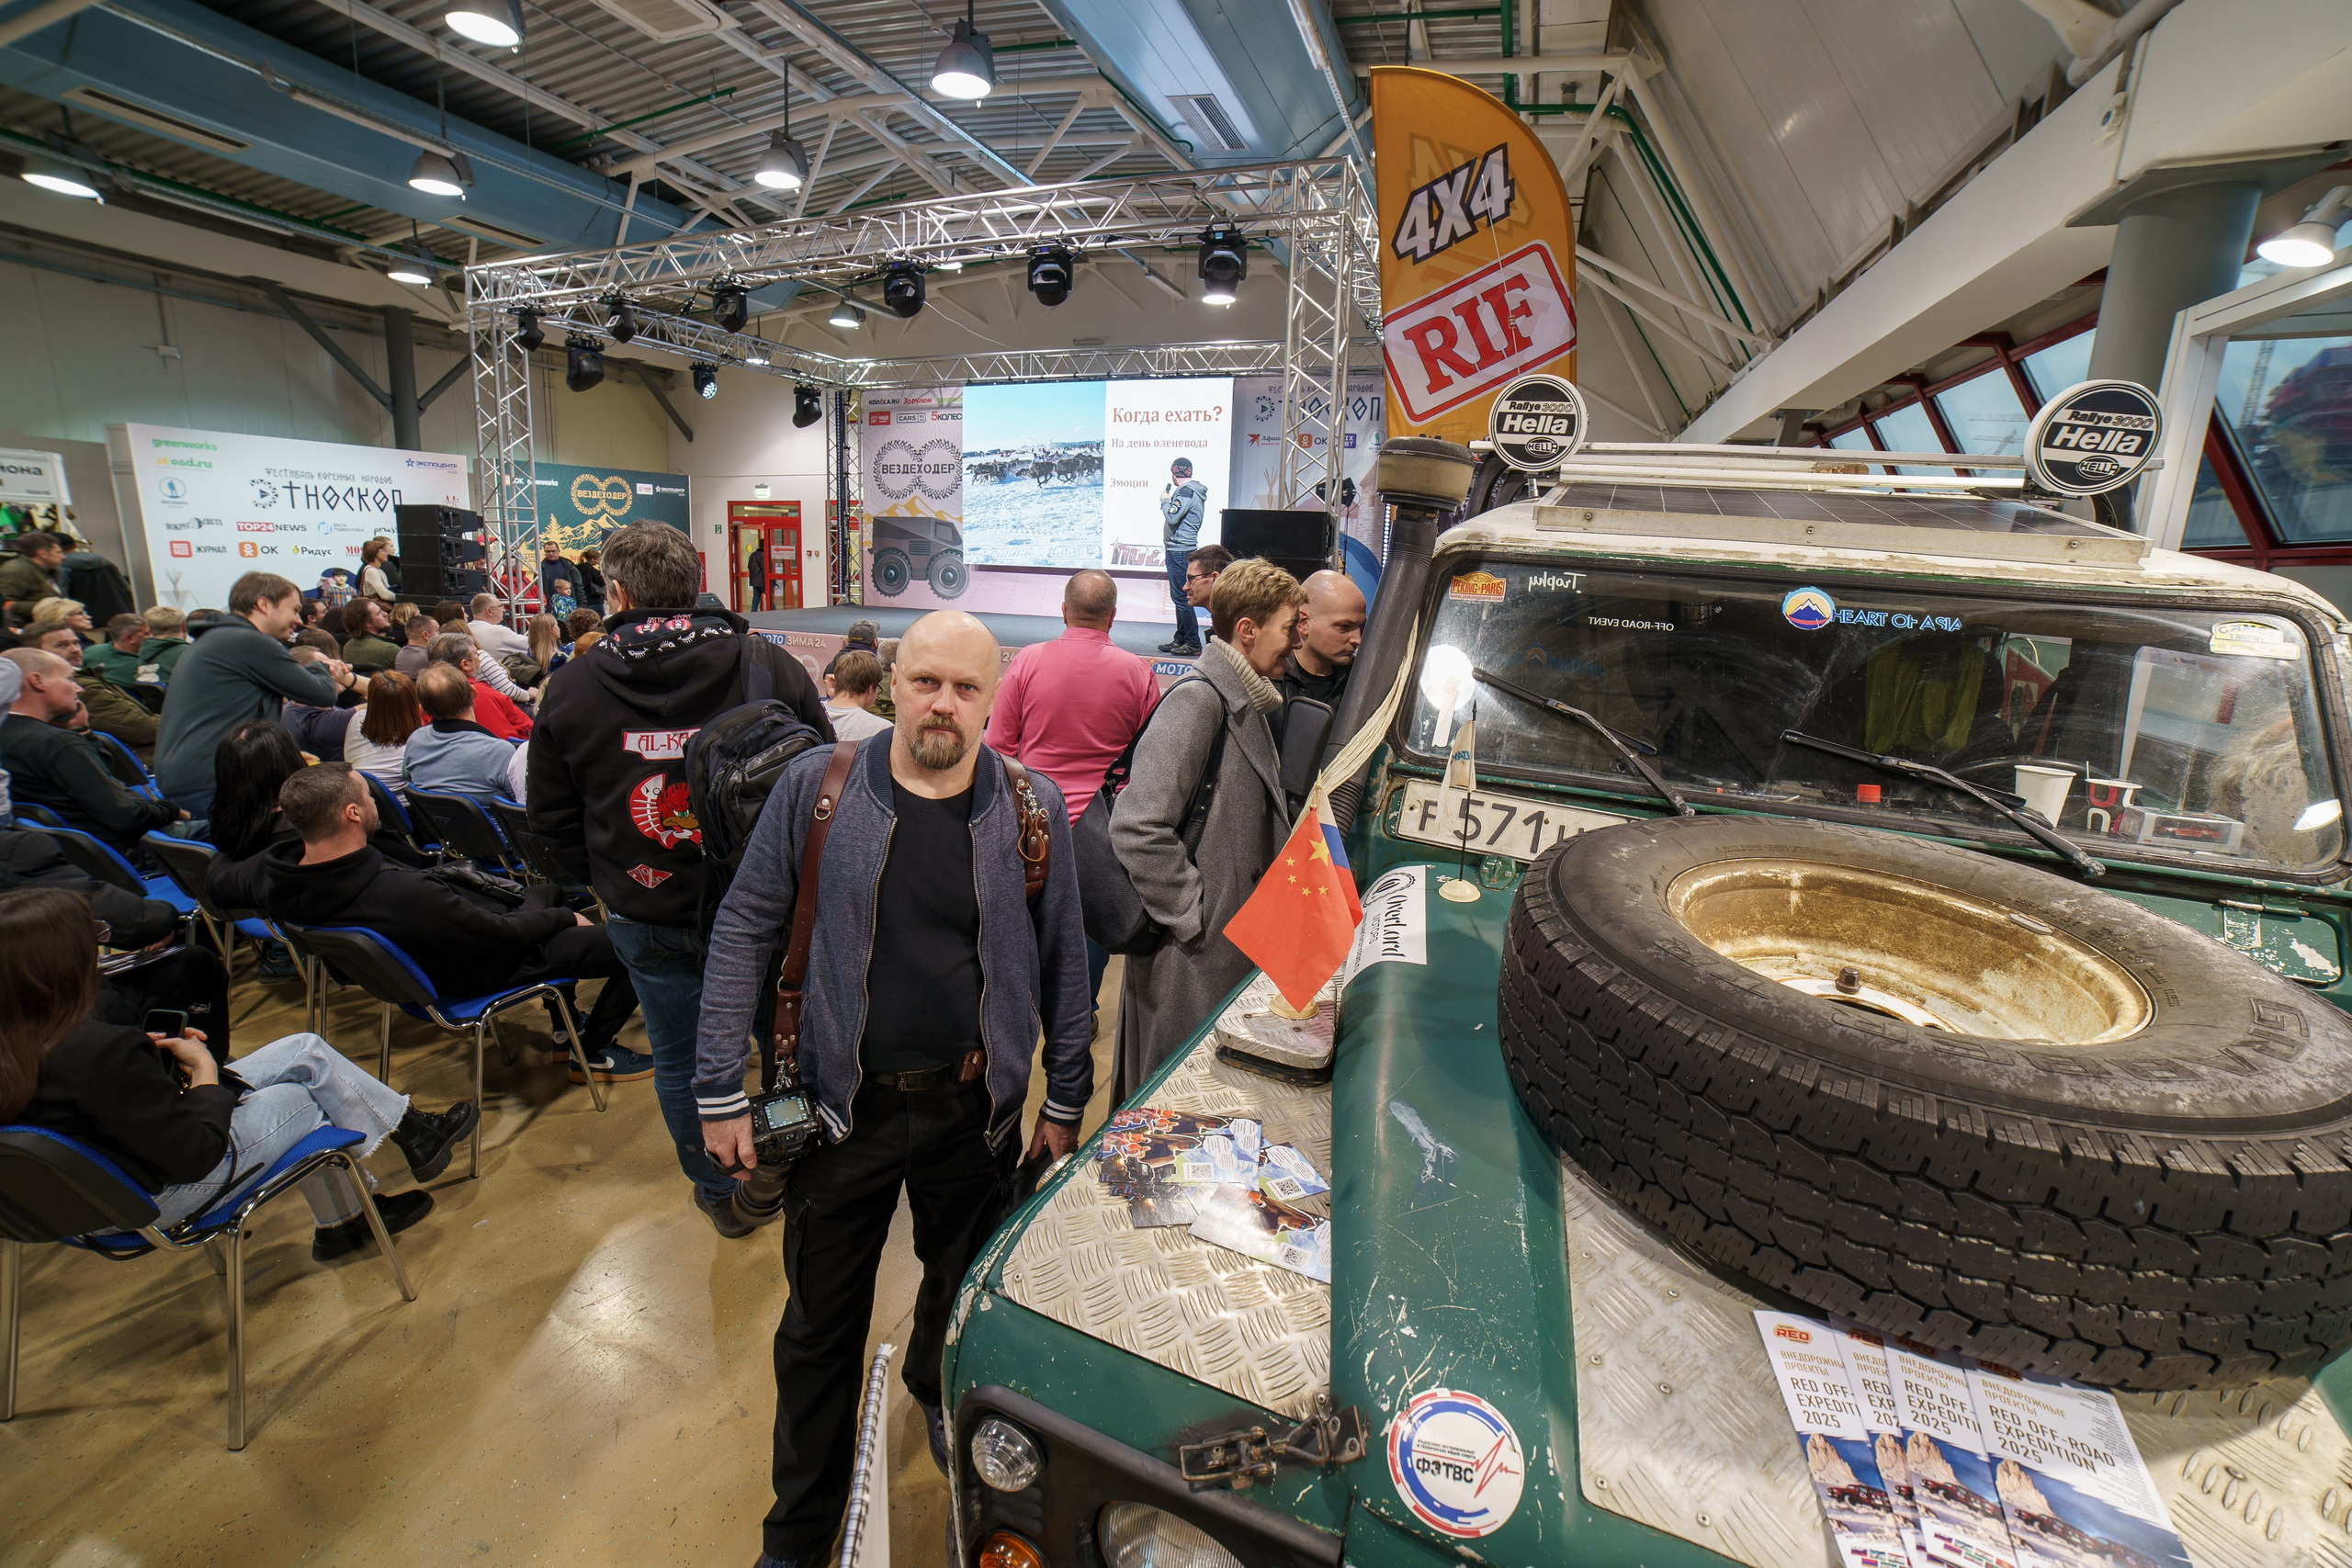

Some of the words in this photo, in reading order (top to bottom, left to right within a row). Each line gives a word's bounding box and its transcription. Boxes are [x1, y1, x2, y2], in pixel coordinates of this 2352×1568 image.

[1402, 273, 1533, 395] RIF
[1113, 407, 1159, 425] Когда
[1165, 405, 1223, 423] ехать?
[1509, 401, 1541, 412] Rallye
[1542, 403, 1573, 412] 3000
[1502, 413, 1568, 434] Hella
[2068, 411, 2113, 424] Rallye
[2113, 415, 2154, 429] 3000
[152, 438, 218, 451] greenworks
[1111, 438, 1125, 448] На
[1126, 439, 1151, 448] день
[1153, 439, 1208, 448] оленевода
[1528, 442, 1558, 454] HELLA
[2052, 425, 2143, 454] Hella
[415, 460, 458, 468] ЭКСПОЦЕНТР
[882, 463, 956, 475] ВЕЗДЕХОДЕР
[2080, 462, 2120, 476] HELLA
[1110, 478, 1148, 490] Эмоции
[577, 490, 628, 500] ВЕЗДЕХОДЕР
[301, 547, 332, 557] Ридус
[1452, 578, 1477, 593] PEKING
[1481, 581, 1505, 595] PARIS
[1832, 609, 1888, 626] HEART
[1919, 615, 1962, 632] ASIA
[763, 634, 784, 645] ОТО
[786, 636, 814, 648] ЗИМА
[814, 637, 826, 649] 24
[1156, 662, 1194, 675] МОТО
[638, 731, 697, 753] AL-KA
[1453, 797, 1545, 854] 571
[1368, 913, 1381, 944] MOTORS
[1776, 1328, 1810, 1341] RED
[1781, 1350, 1846, 1370] ВНЕДОРОЖНЫ
[1784, 1361, 1829, 1376] ПРОЕКТЫ
[1856, 1363, 1890, 1378] ПРОЕК
[1901, 1365, 1950, 1390] ПРОЕКТЫ
[1791, 1377, 1818, 1393] RED
[1823, 1382, 1855, 1398] OFF-
[1862, 1378, 1892, 1395] RED
[1796, 1393, 1861, 1417] EXPEDITI
[1904, 1380, 1934, 1399] RED
[1939, 1393, 1975, 1415] OFF-
[1981, 1379, 2067, 1419] ВНЕДОРОЖНЫЕ
[1984, 1389, 2038, 1416] ПРОЕКТЫ
[1803, 1410, 1840, 1428] 2025
[1873, 1410, 1901, 1428] 202
[1907, 1394, 1983, 1434] EXPEDITI
[1911, 1410, 1951, 1435] 2025
[1988, 1404, 2021, 1426] RED
[2028, 1419, 2115, 1467] OFF-ROAD
[1993, 1420, 2098, 1473] EXPEDITION
[1998, 1437, 2042, 1464] 2025
[1416, 1457, 1474, 1483] ФЭТВС
